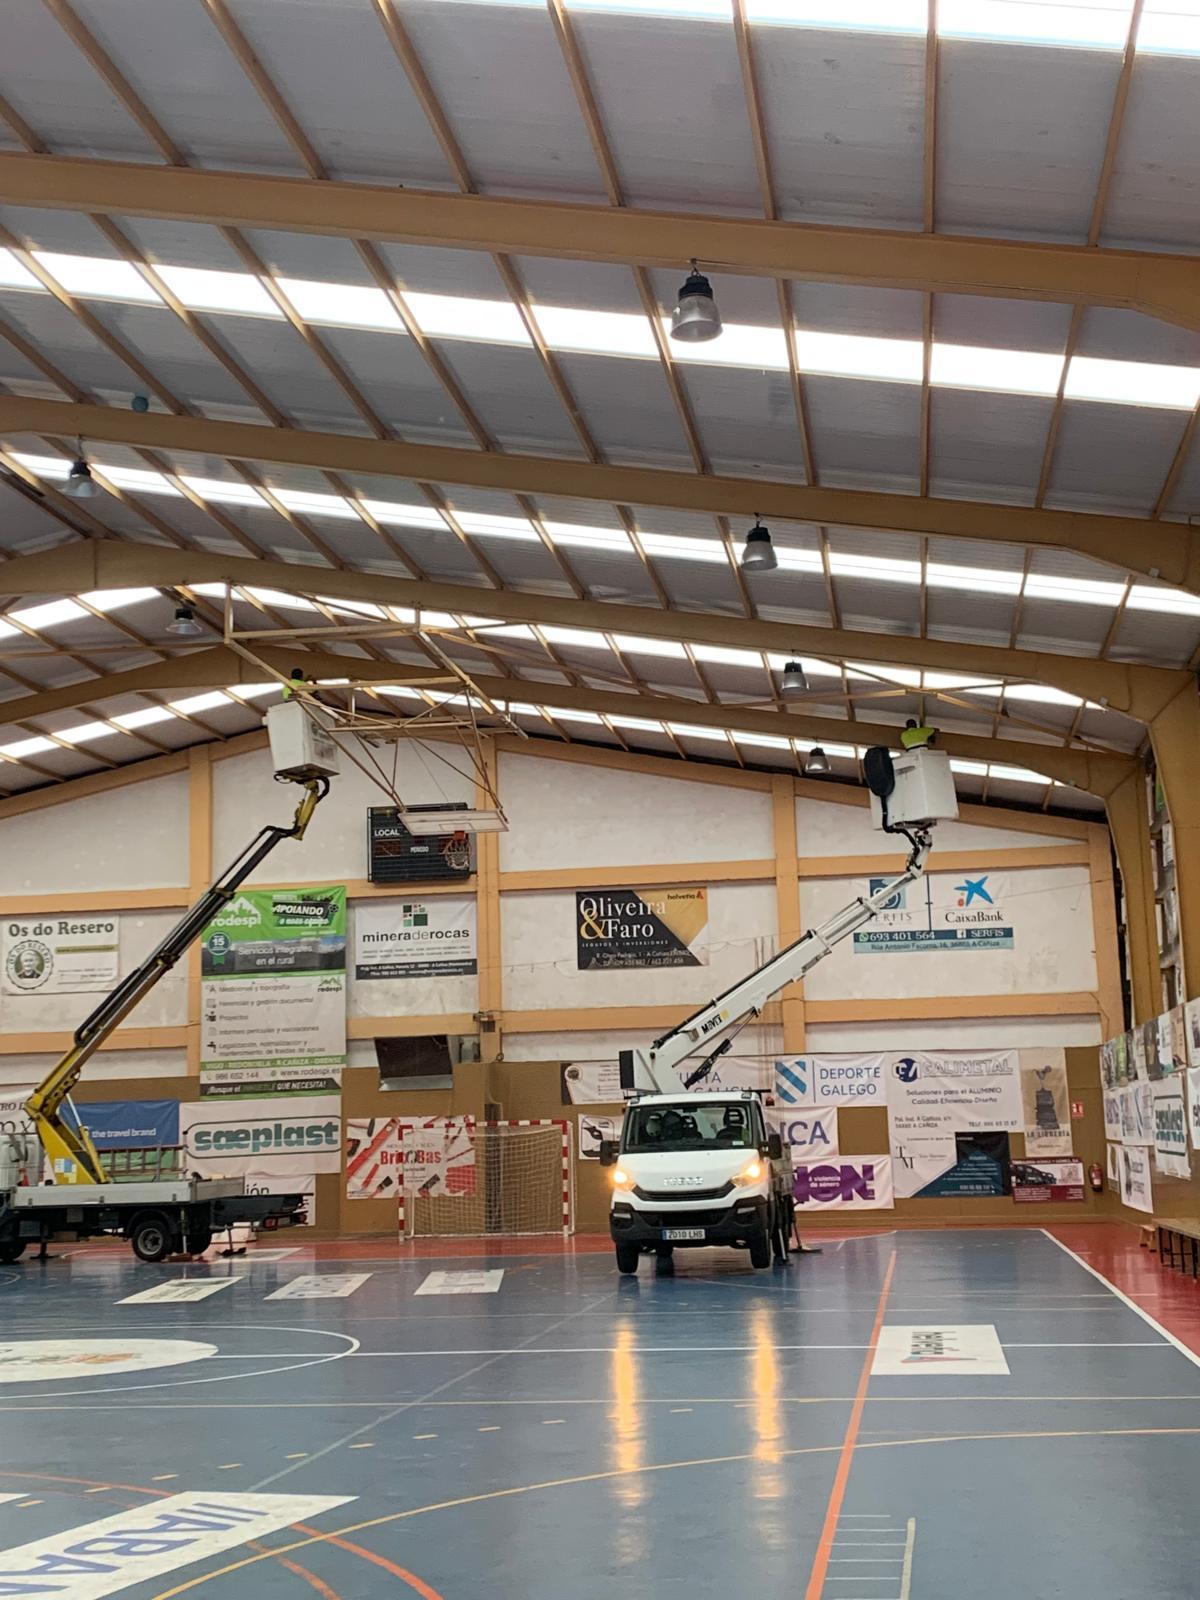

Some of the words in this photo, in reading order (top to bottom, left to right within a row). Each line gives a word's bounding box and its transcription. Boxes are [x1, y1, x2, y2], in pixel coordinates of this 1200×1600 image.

[374, 829, 400, 837] LOCAL
[273, 904, 324, 915] APOIANDO
[580, 898, 666, 917] Oliveira
[868, 913, 912, 921] ERFIS
[945, 911, 1004, 924] CaixaBank
[9, 924, 28, 937] Os
[33, 923, 53, 936] do
[57, 921, 114, 935] Resero
[600, 918, 654, 938] Faro
[971, 929, 1004, 938] SERFIS
[362, 929, 470, 942] mineraderocas
[870, 933, 889, 941] 693
[892, 932, 911, 940] 401
[915, 931, 935, 940] 564
[213, 938, 225, 946] 15
[623, 940, 669, 948] INVERSIONES
[820, 1067, 881, 1080] DEPORTE
[820, 1083, 877, 1096] GALEGO
[107, 1129, 130, 1137] travel
[132, 1128, 156, 1136] brand
